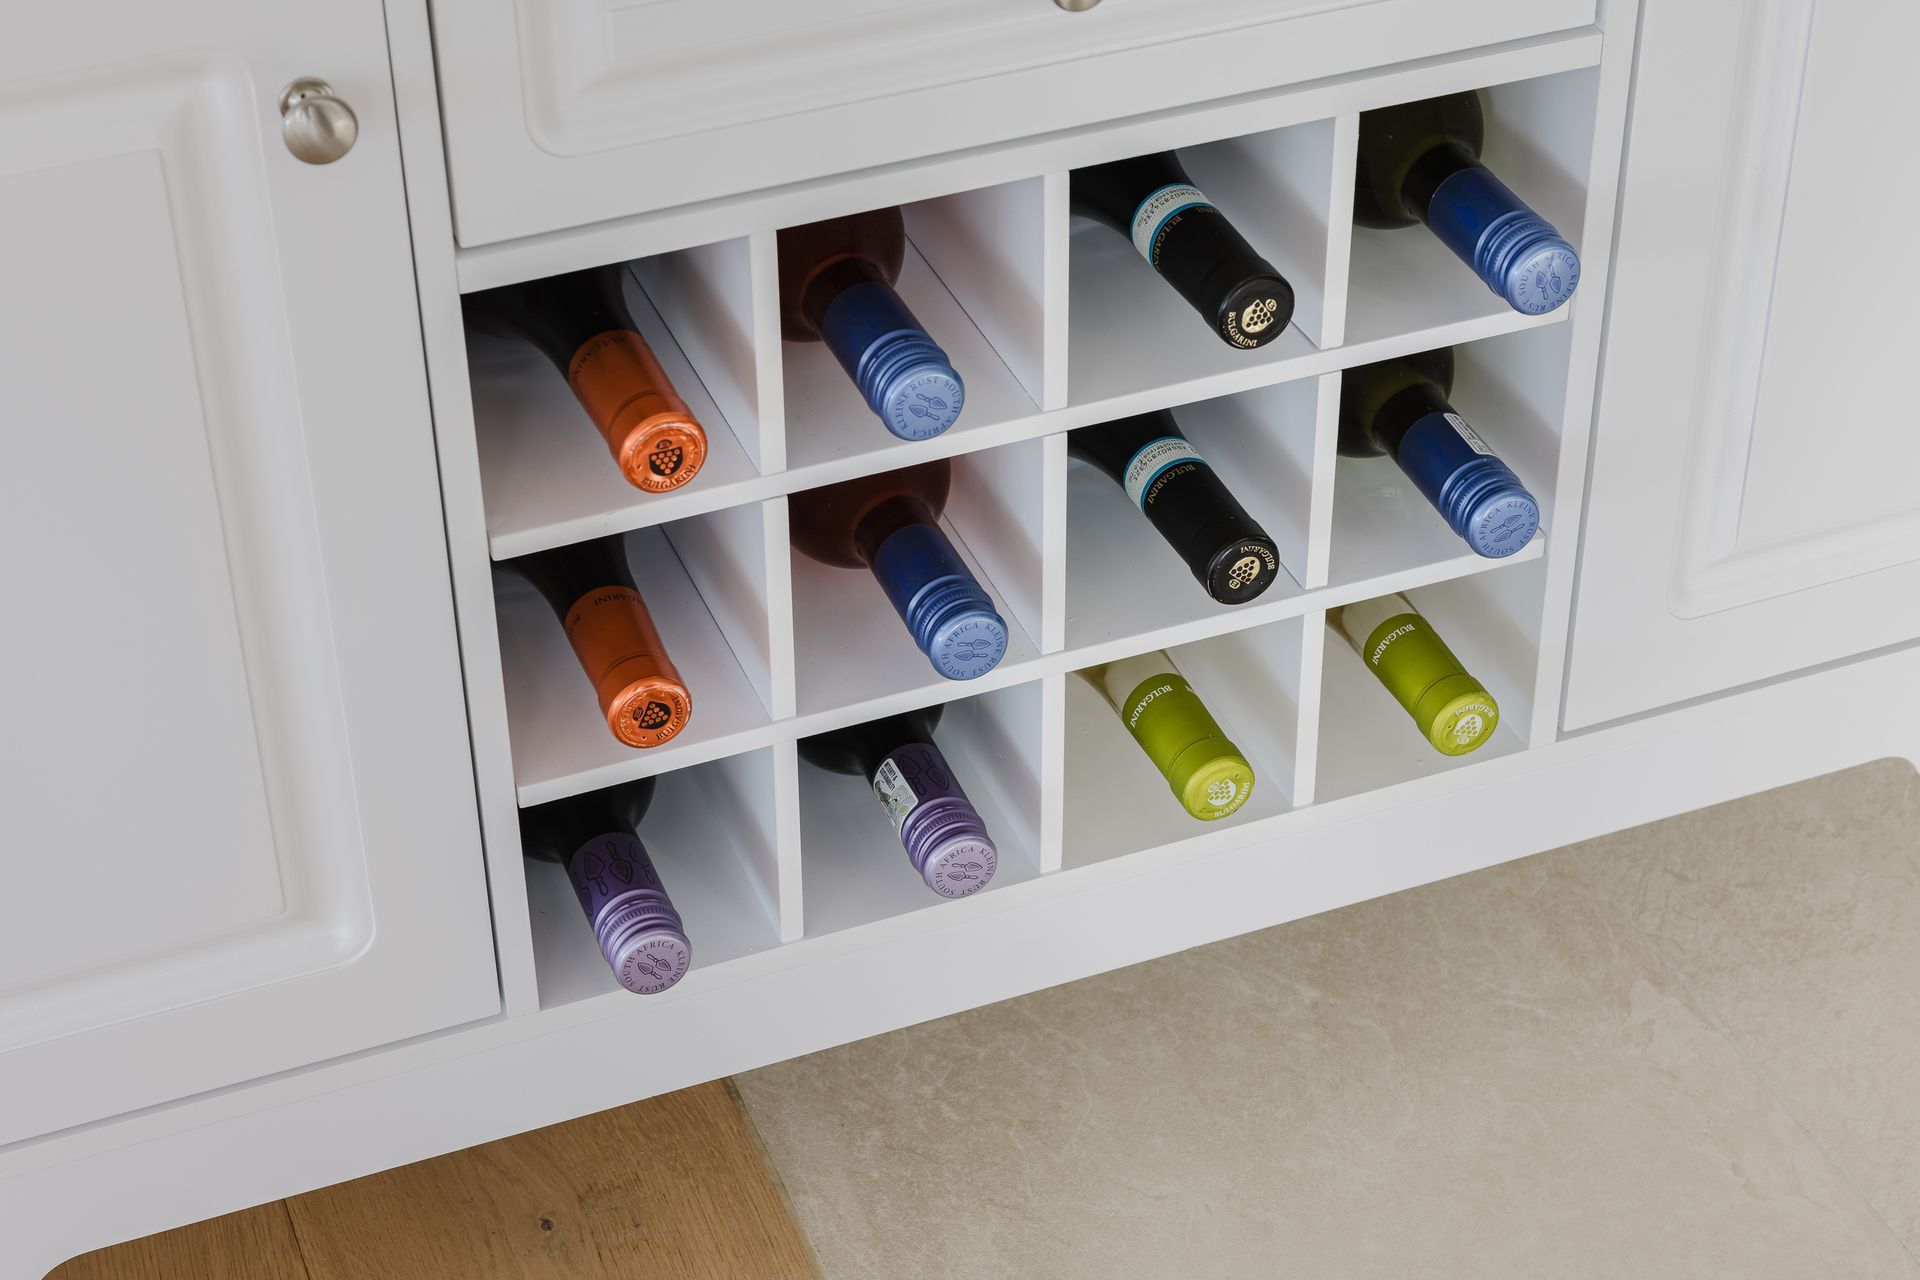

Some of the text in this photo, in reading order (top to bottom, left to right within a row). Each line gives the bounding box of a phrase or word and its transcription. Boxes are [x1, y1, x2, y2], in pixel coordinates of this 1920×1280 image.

[1519, 261, 1539, 296] SOUTH
[1550, 274, 1578, 309] KLEINE
[1522, 300, 1547, 313] RUST
[1228, 311, 1258, 347] BULGARINI
[895, 376, 961, 438] KLEINE RUST SOUTH AFRICA
[641, 464, 698, 491] BULGARINI
[1147, 463, 1197, 505] BULGARINI
[1479, 500, 1537, 556] KLEINE RUST SOUTH AFRICA
[1240, 545, 1275, 571] BULGARINI
[942, 622, 1003, 677] KLEINE RUST SOUTH AFRICA
[1372, 624, 1416, 666] BULGARINI
[656, 695, 684, 740] BULGARINI
[1130, 684, 1173, 728] BULGARINI
[1214, 781, 1250, 818] BULGARINI
[935, 846, 995, 896] KLEINE RUST SOUTH AFRICA
[623, 940, 686, 993] KLEINE RUST SOUTH AFRICA
